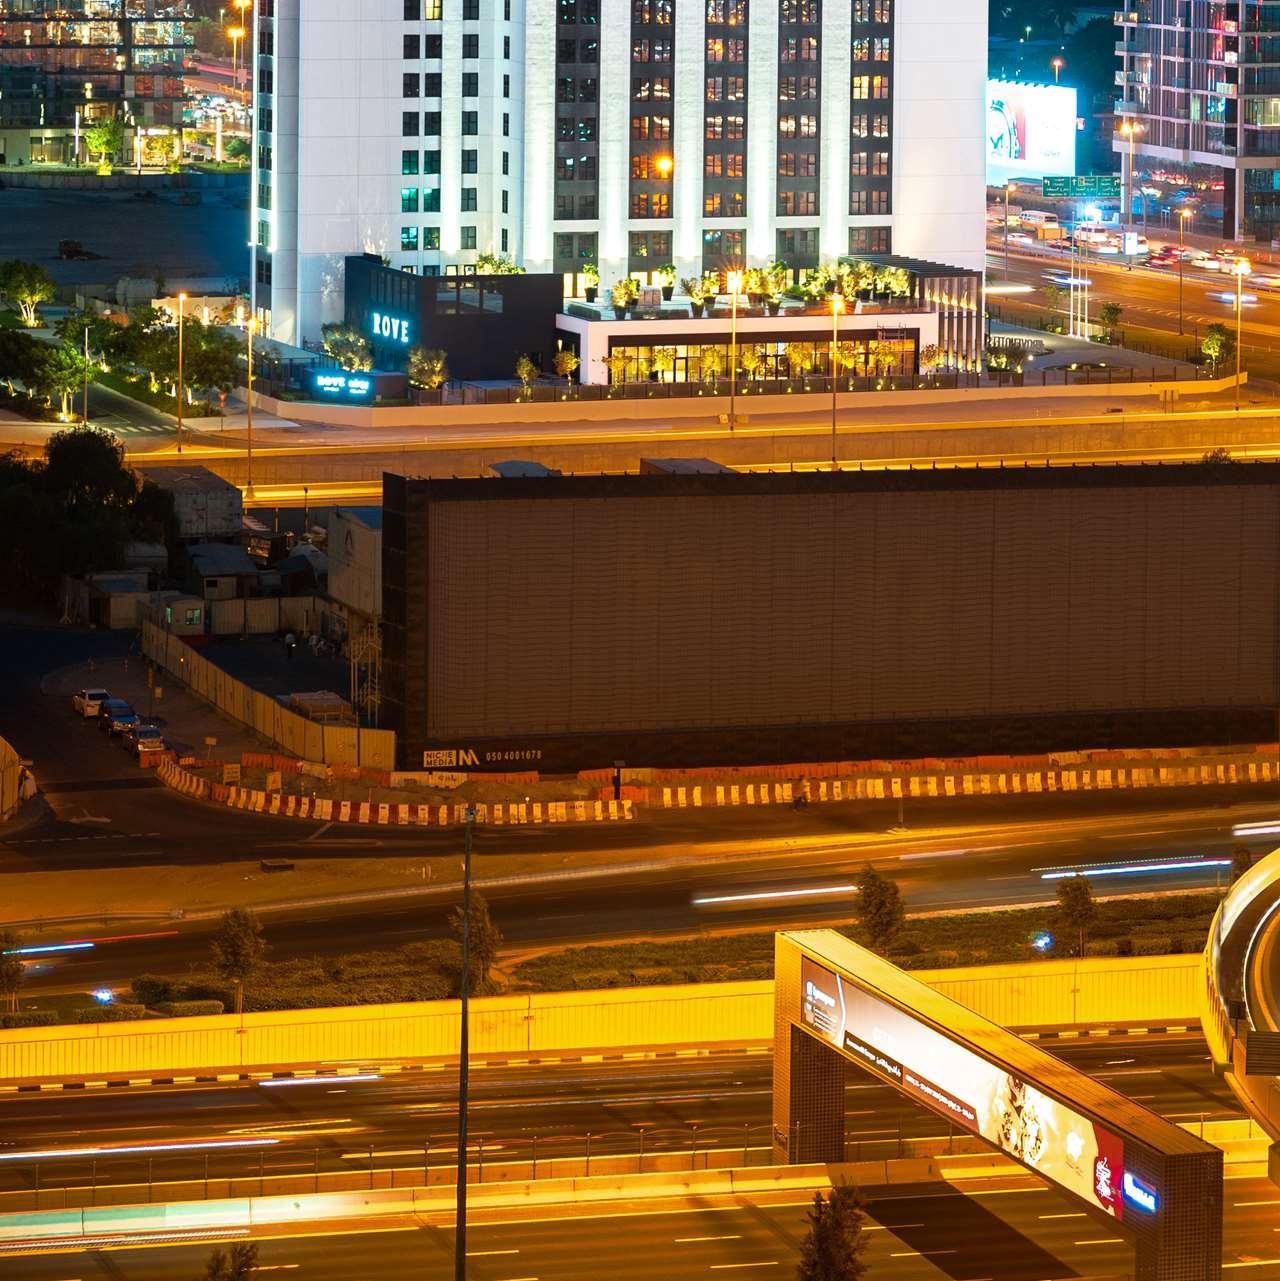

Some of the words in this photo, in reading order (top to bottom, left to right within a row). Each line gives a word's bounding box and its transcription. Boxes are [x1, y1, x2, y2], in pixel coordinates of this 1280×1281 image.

[373, 312, 409, 343] ROVE
[425, 751, 453, 759] NICHE
[486, 752, 502, 761] 050
[425, 759, 453, 767] MEDIA
